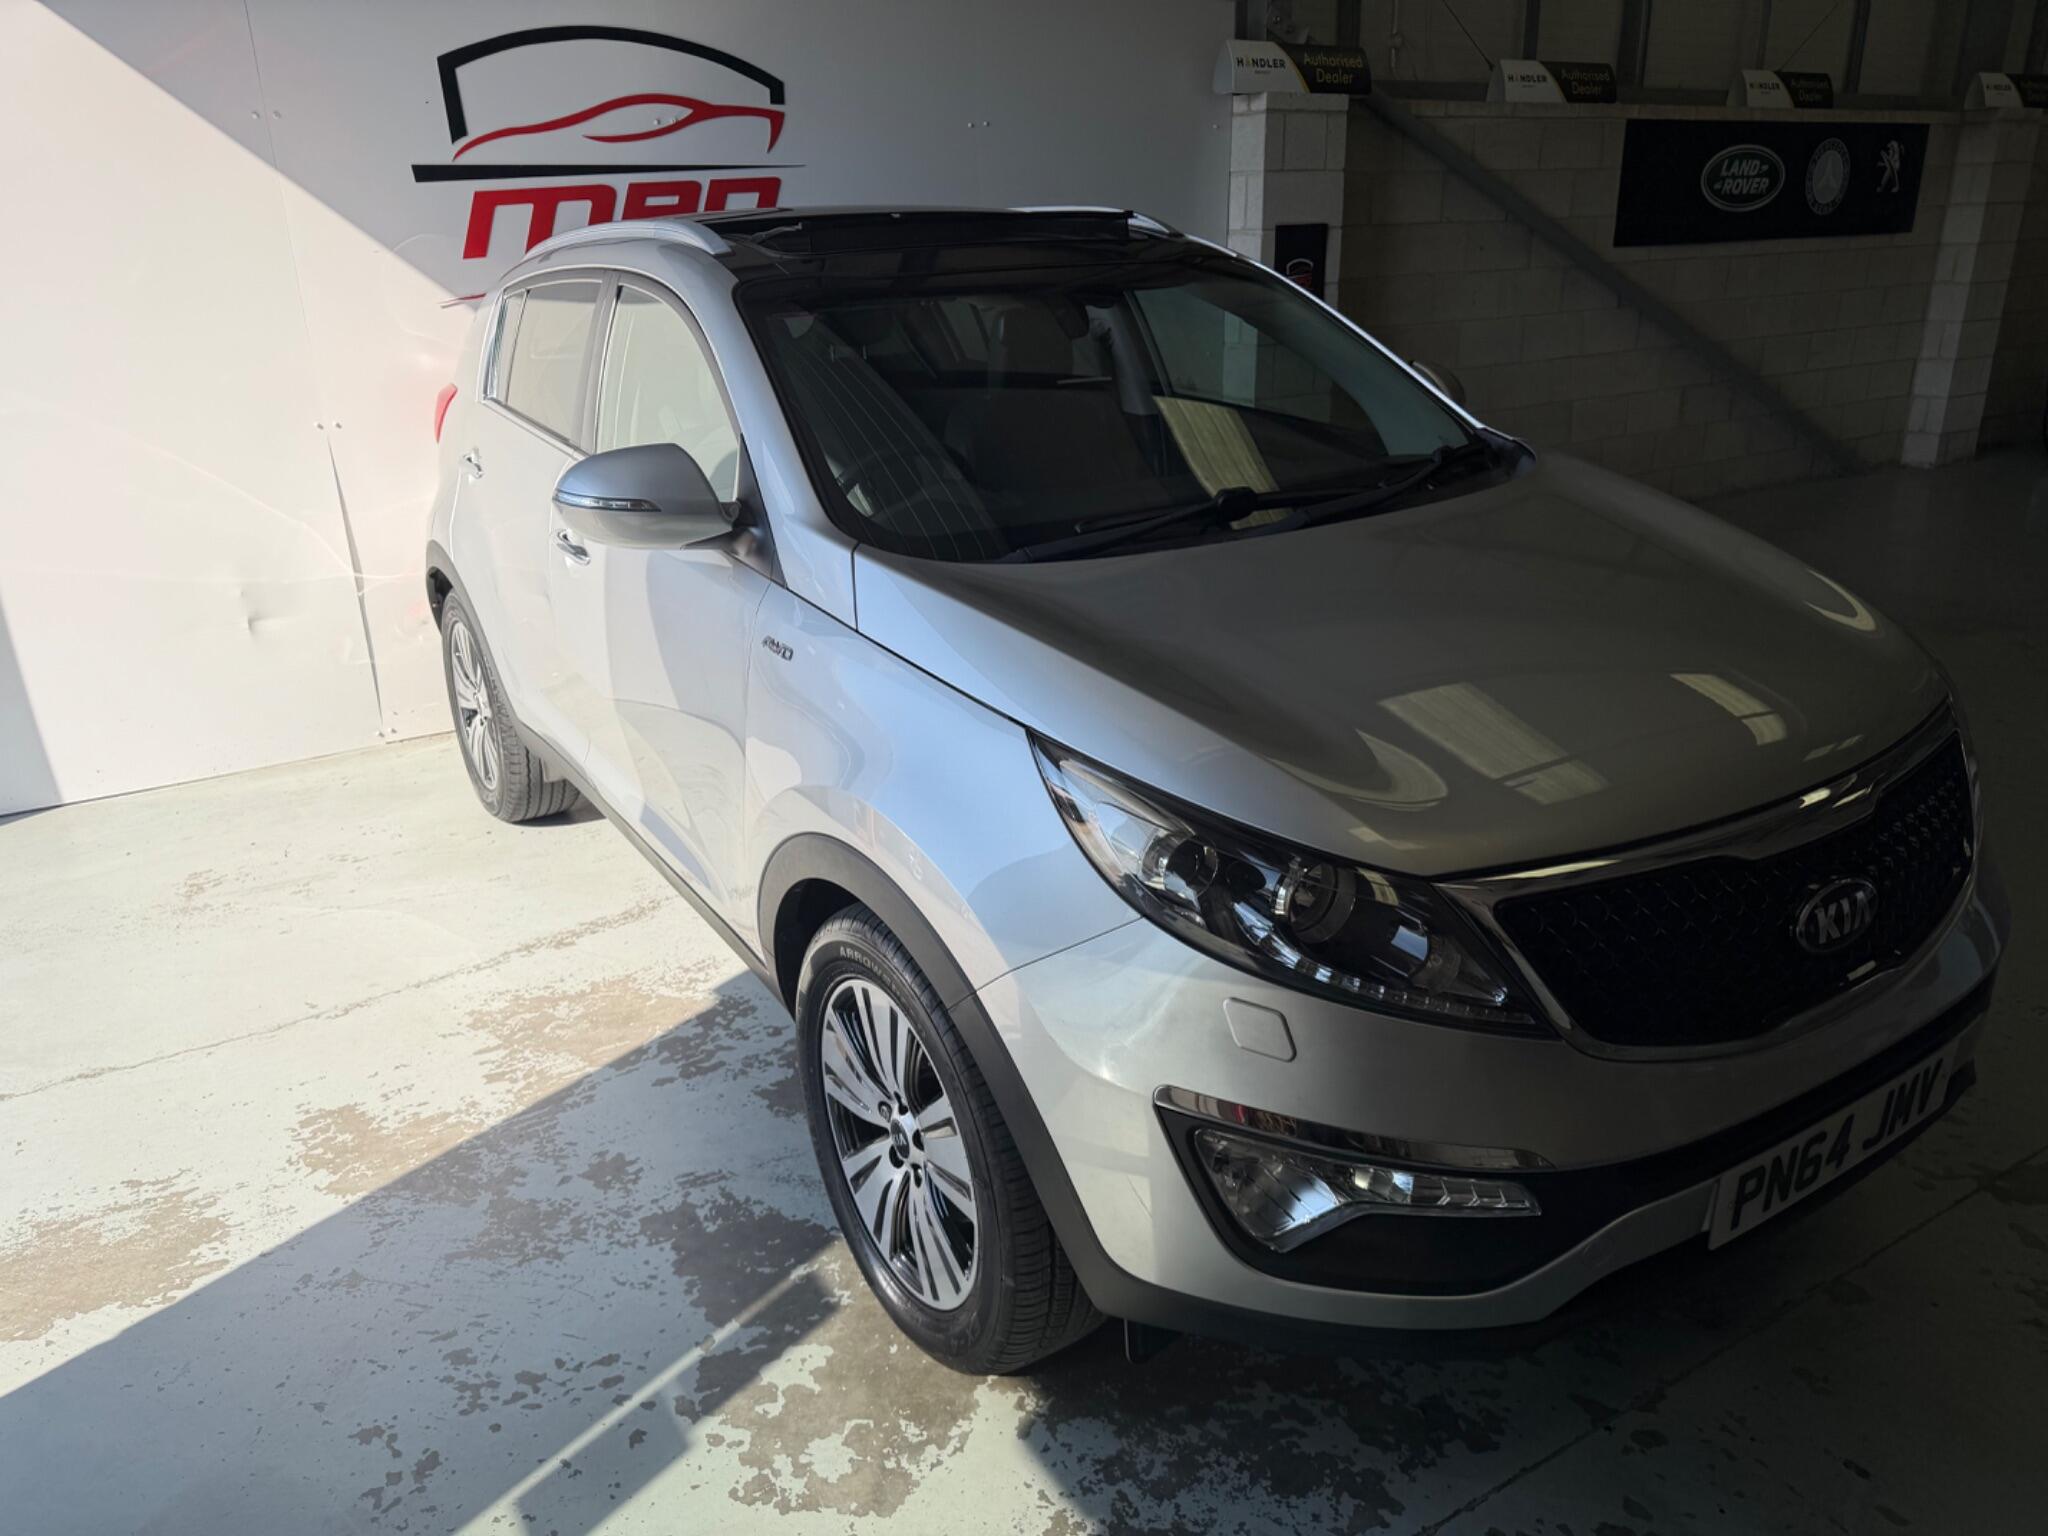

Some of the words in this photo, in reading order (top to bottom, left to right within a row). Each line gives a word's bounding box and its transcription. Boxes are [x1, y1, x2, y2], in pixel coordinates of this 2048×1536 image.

[1303, 51, 1363, 68] Authorised
[1315, 68, 1353, 84] Dealer
[1560, 68, 1610, 82] Authorised
[1720, 159, 1761, 176] LAND
[1720, 177, 1770, 195] ROVER
[1731, 1113, 1855, 1231] PN64
[1862, 1057, 1943, 1150] JMV
